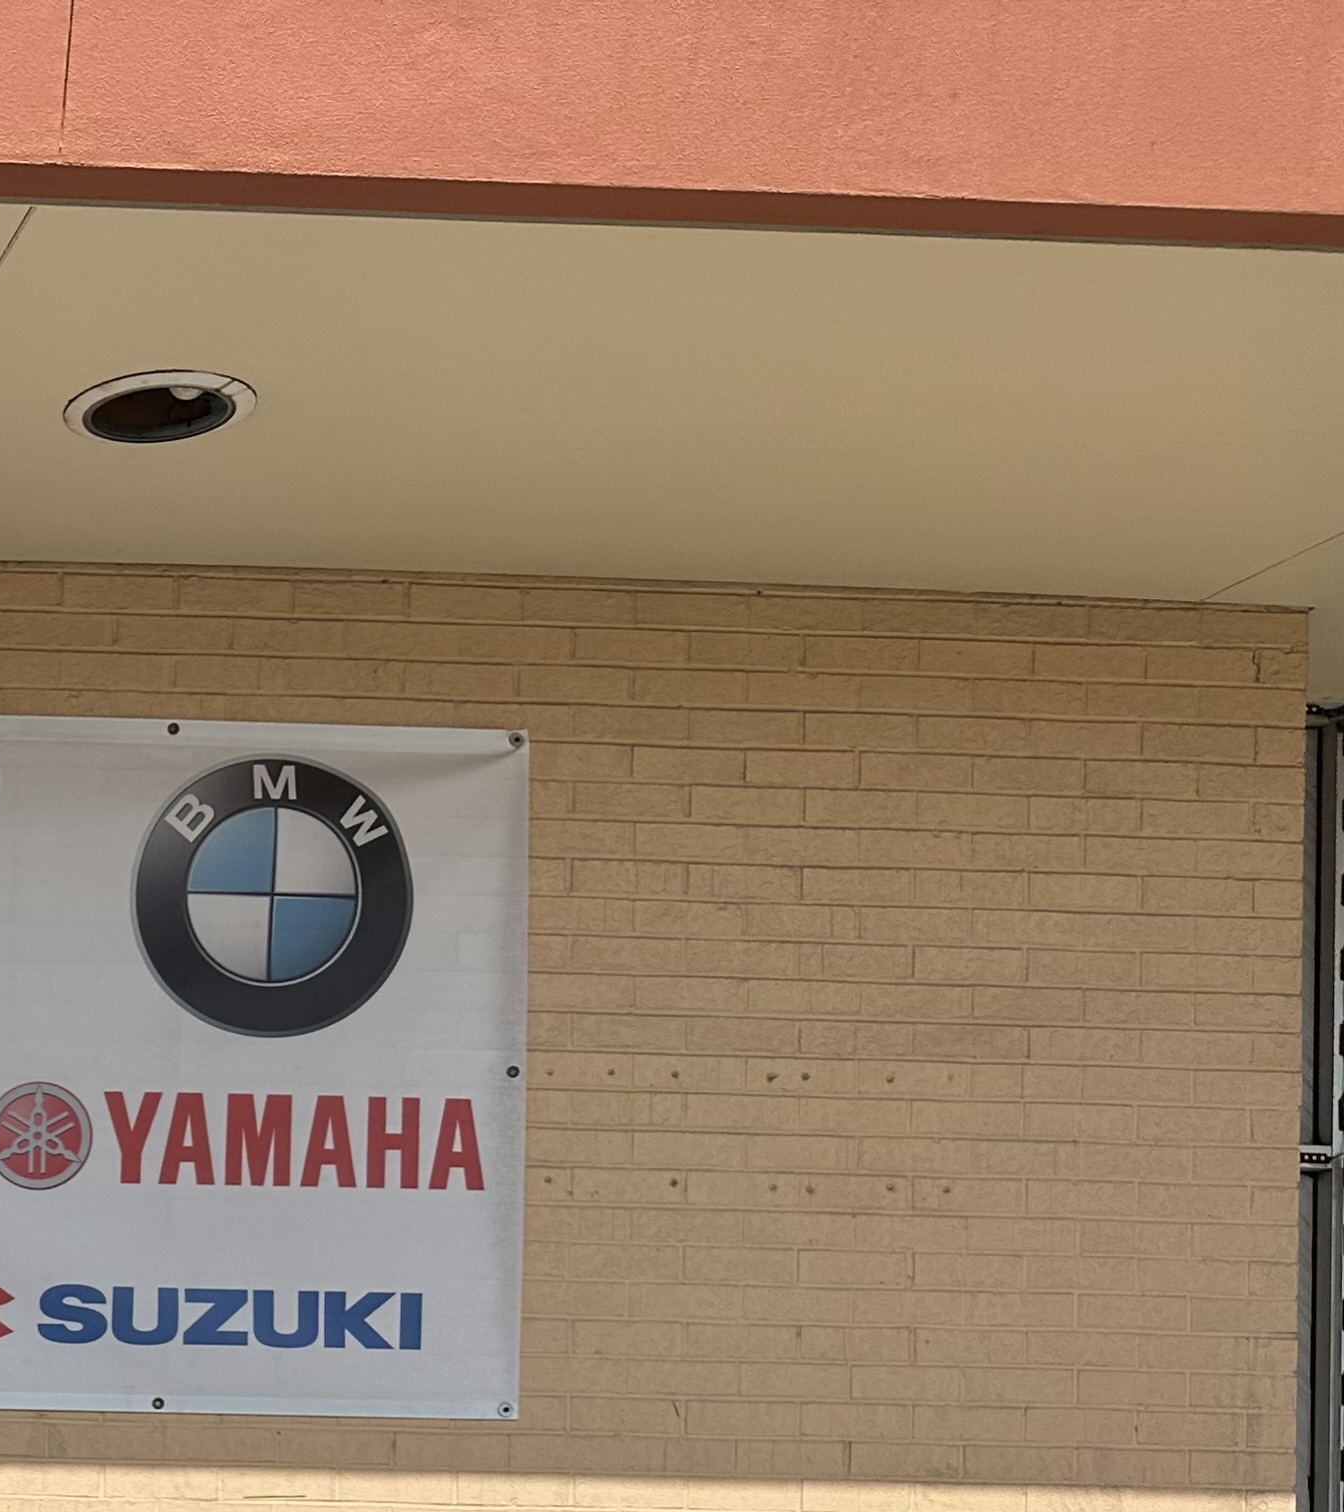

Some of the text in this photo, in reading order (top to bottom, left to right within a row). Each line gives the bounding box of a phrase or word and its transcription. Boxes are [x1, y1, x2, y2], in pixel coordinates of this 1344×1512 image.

[164, 763, 388, 848] BMW
[103, 1091, 485, 1190] YAMAHA
[37, 1284, 423, 1351] SUZUKI
